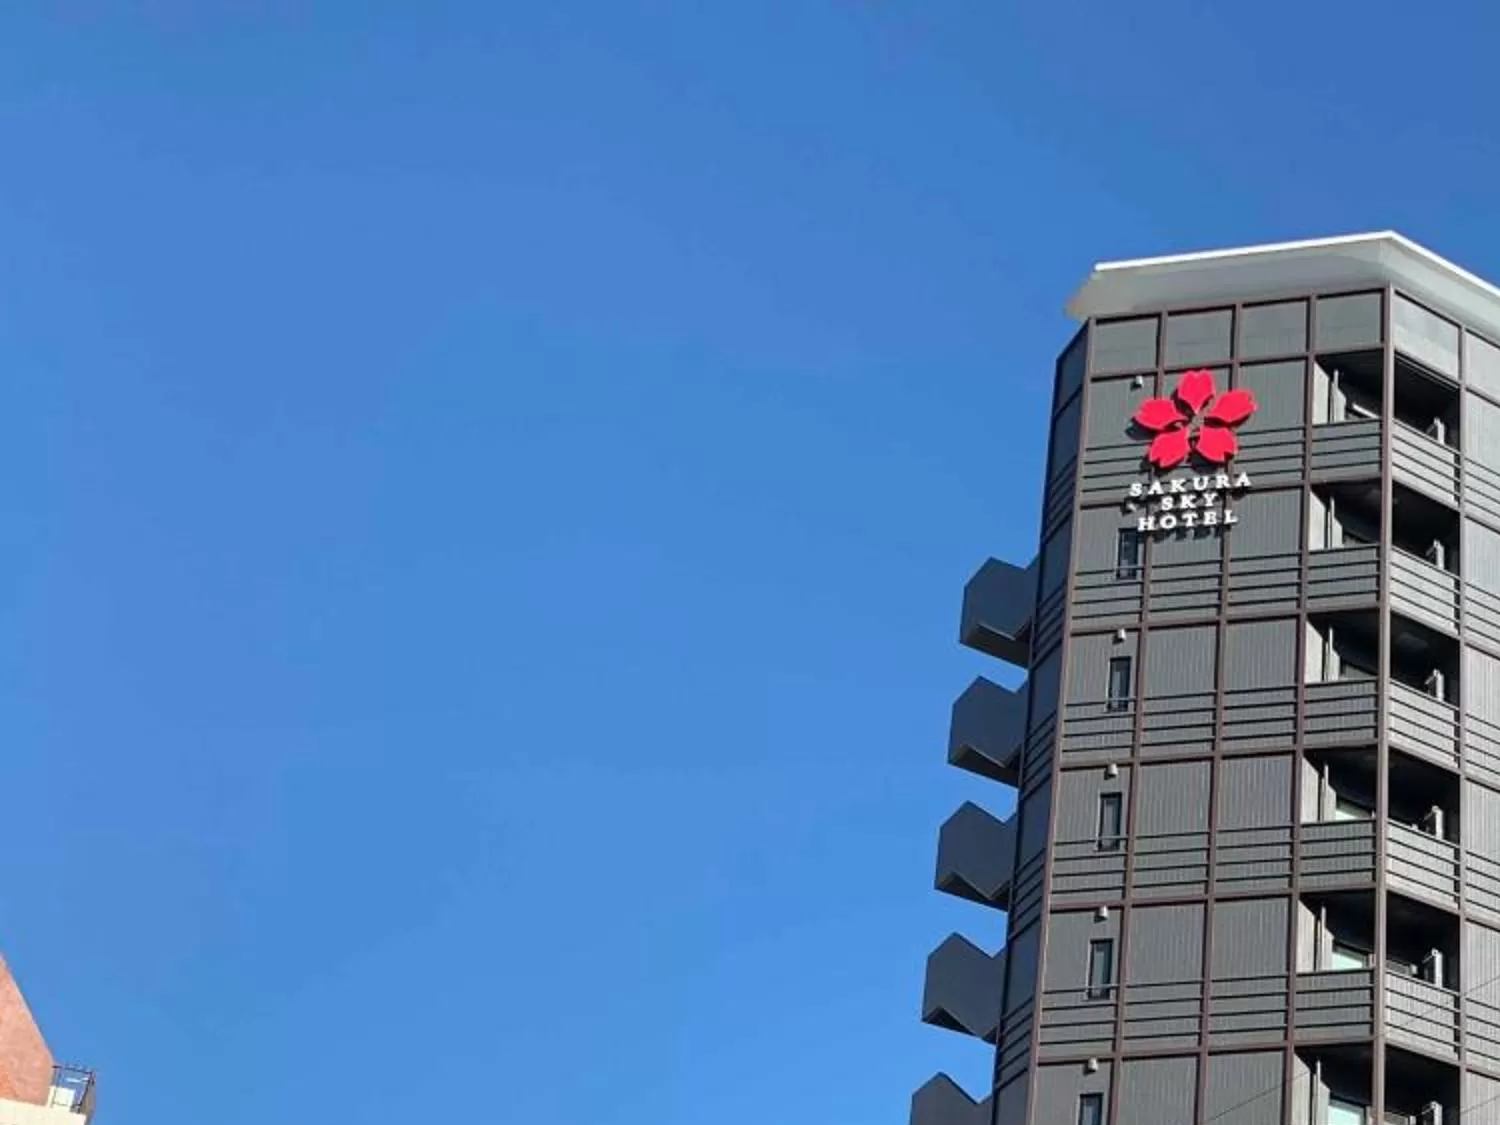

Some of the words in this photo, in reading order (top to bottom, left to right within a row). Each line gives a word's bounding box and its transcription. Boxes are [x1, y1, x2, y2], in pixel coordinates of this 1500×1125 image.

[1129, 472, 1251, 497] SAKURA
[1161, 493, 1218, 511] SKY
[1138, 510, 1238, 531] HOTEL
